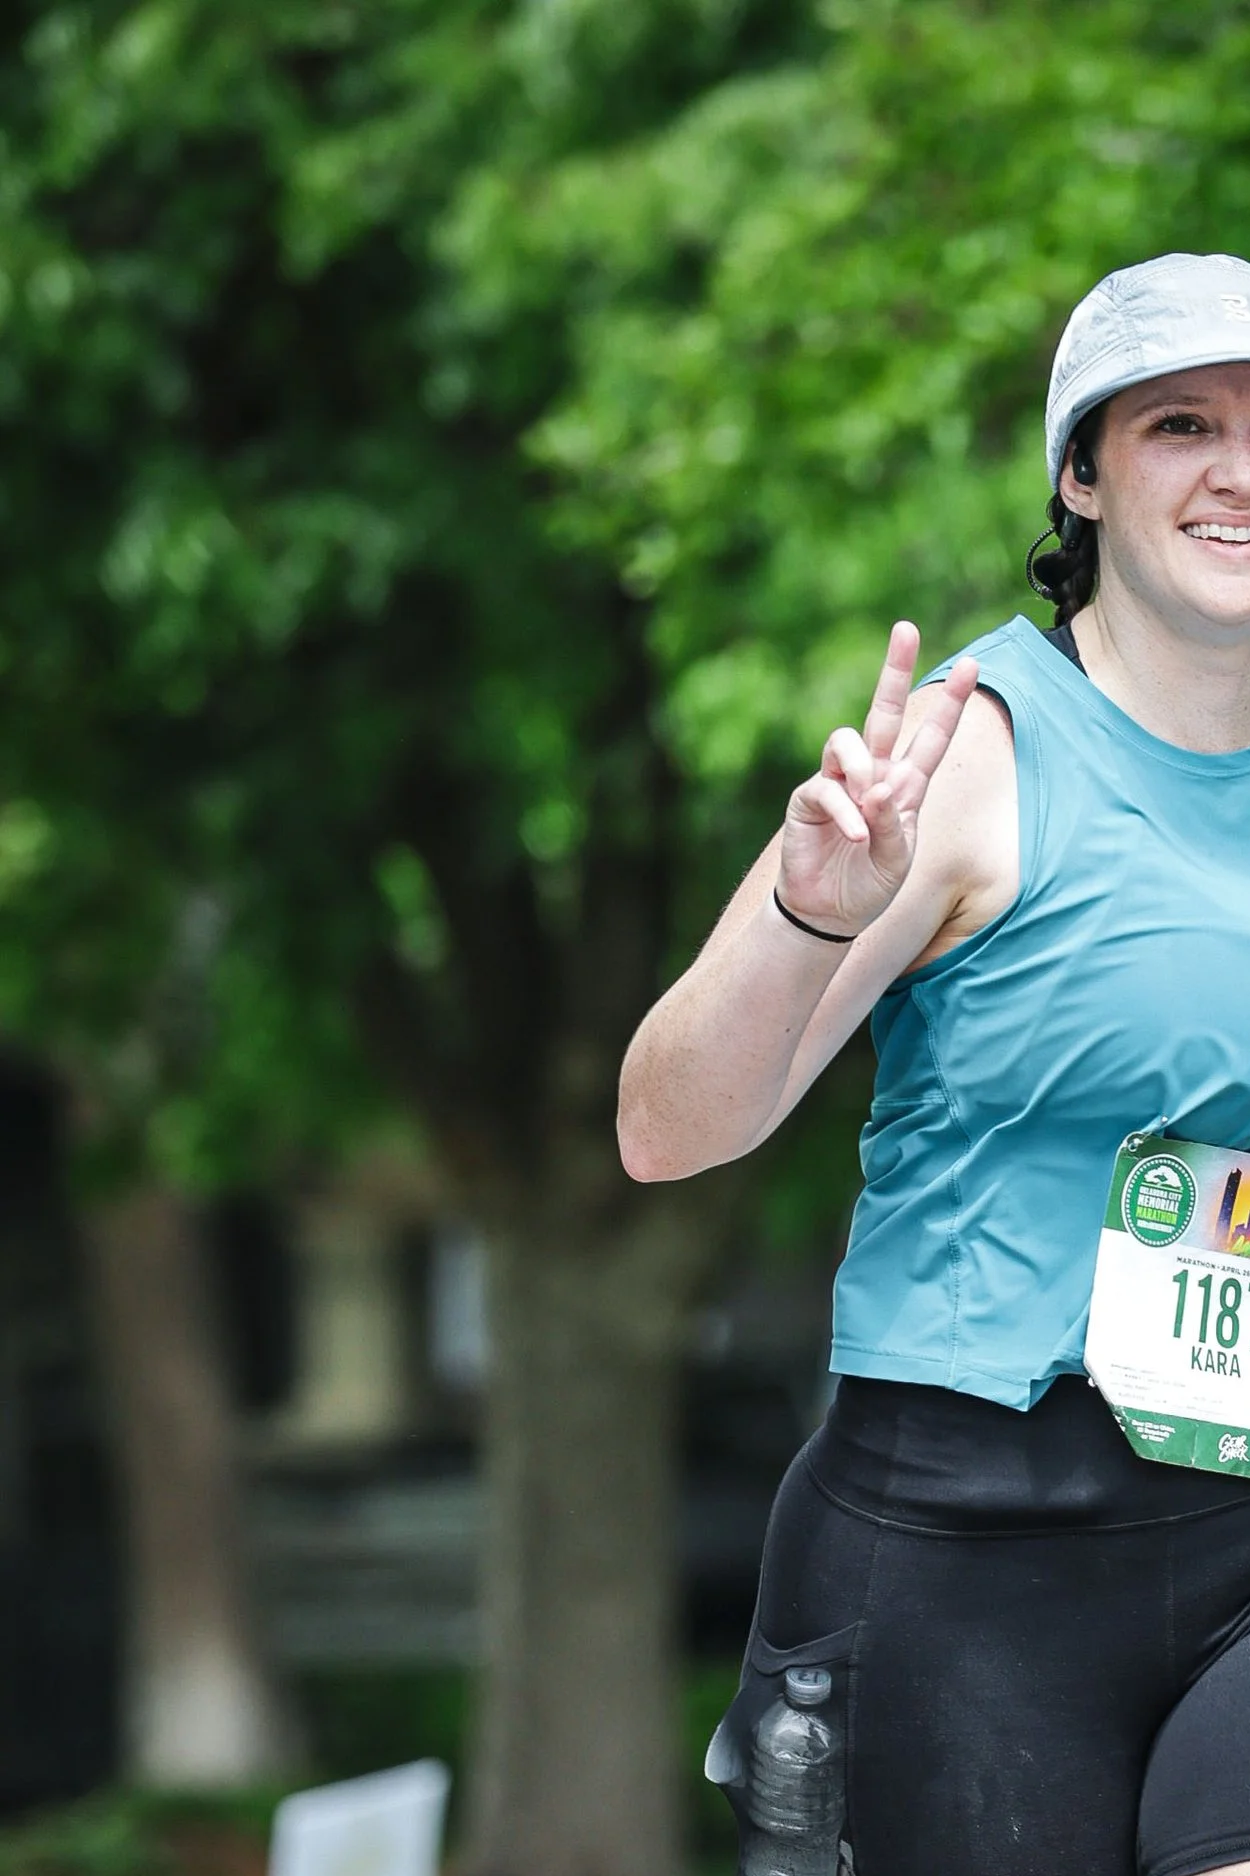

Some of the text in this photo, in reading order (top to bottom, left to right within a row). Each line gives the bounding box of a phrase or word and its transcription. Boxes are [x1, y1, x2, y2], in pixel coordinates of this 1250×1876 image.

[1137, 1193, 1180, 1214] MEMORIAL
[1168, 1191, 1183, 1202] CITY
[1135, 1205, 1178, 1226] MARATHON
[1176, 1256, 1216, 1270] MARATHON
[1220, 1264, 1241, 1276] APRIL
[1190, 1345, 1242, 1379] KARA
